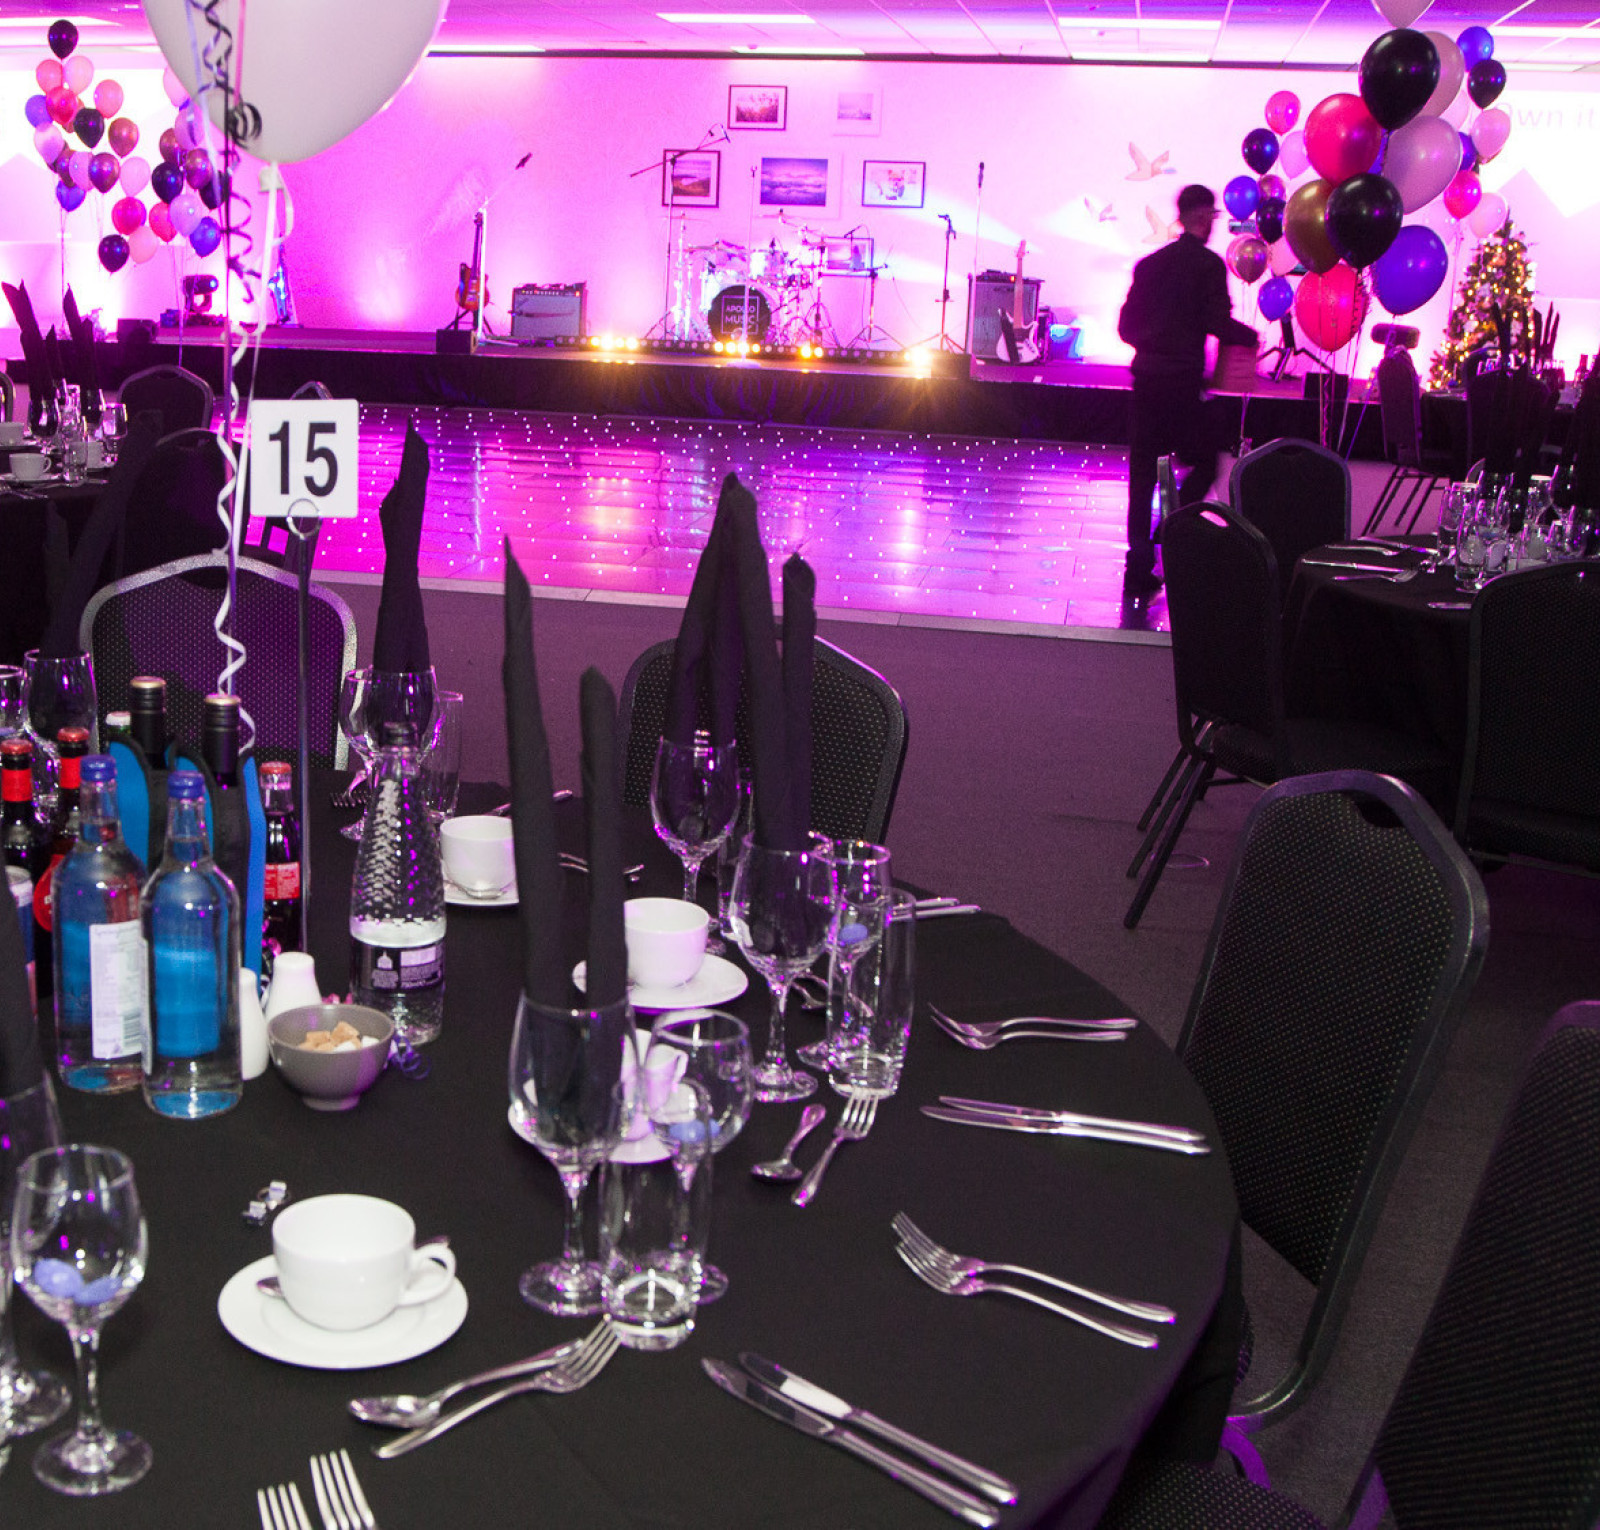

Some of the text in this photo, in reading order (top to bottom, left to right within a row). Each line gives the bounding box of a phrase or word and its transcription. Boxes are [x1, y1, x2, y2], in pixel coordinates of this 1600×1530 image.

[725, 305, 755, 313] APOLO
[725, 315, 755, 324] MUSC
[269, 421, 338, 497] 15
